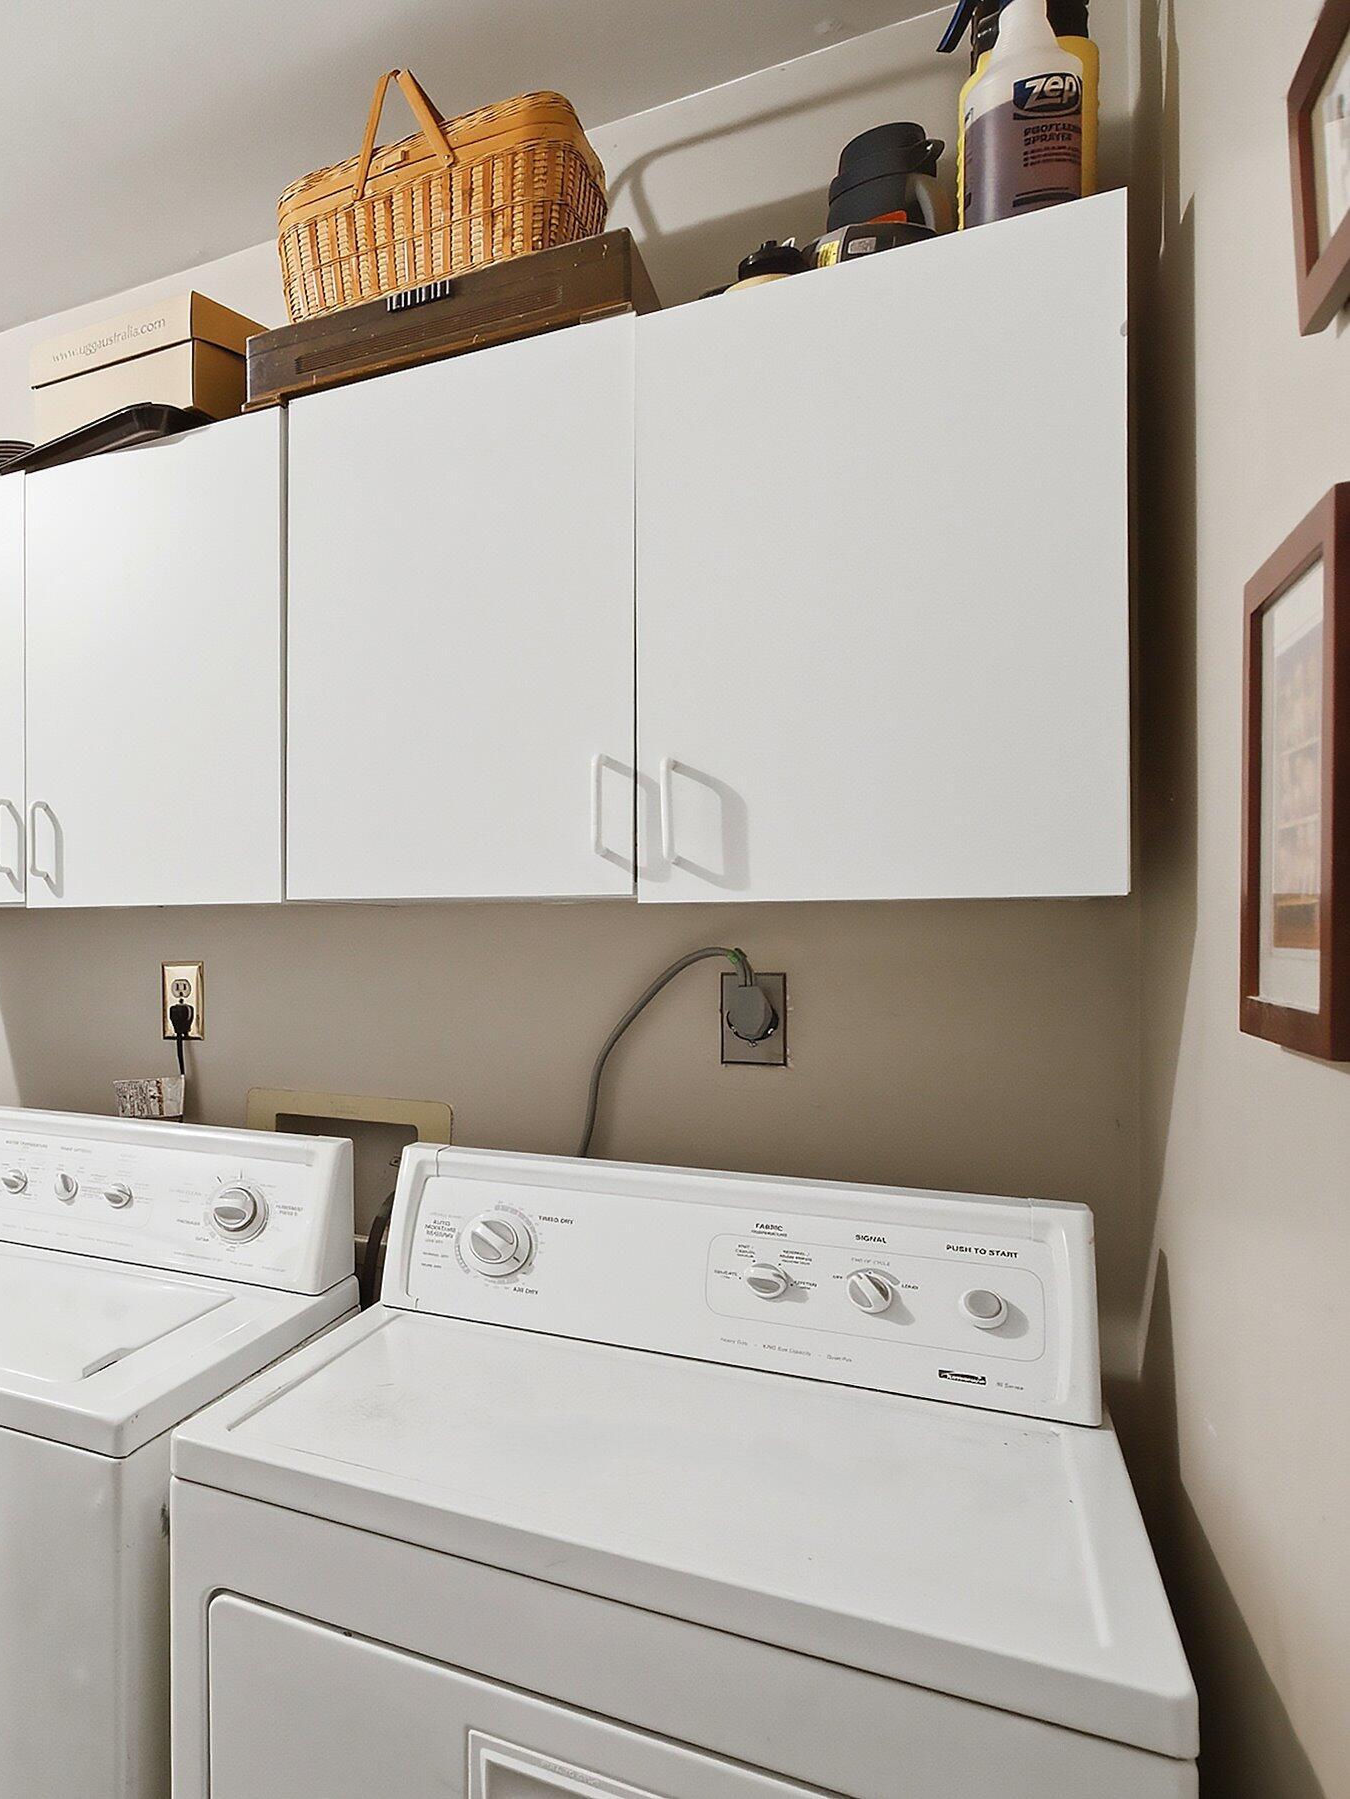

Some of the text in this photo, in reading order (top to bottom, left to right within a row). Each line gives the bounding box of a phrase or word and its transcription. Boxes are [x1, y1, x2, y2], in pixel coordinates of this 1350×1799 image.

[52, 317, 166, 363] www.uggaustralia.com
[855, 1234, 887, 1244] SIGNAL
[946, 1244, 1018, 1259] PUSH TO START
